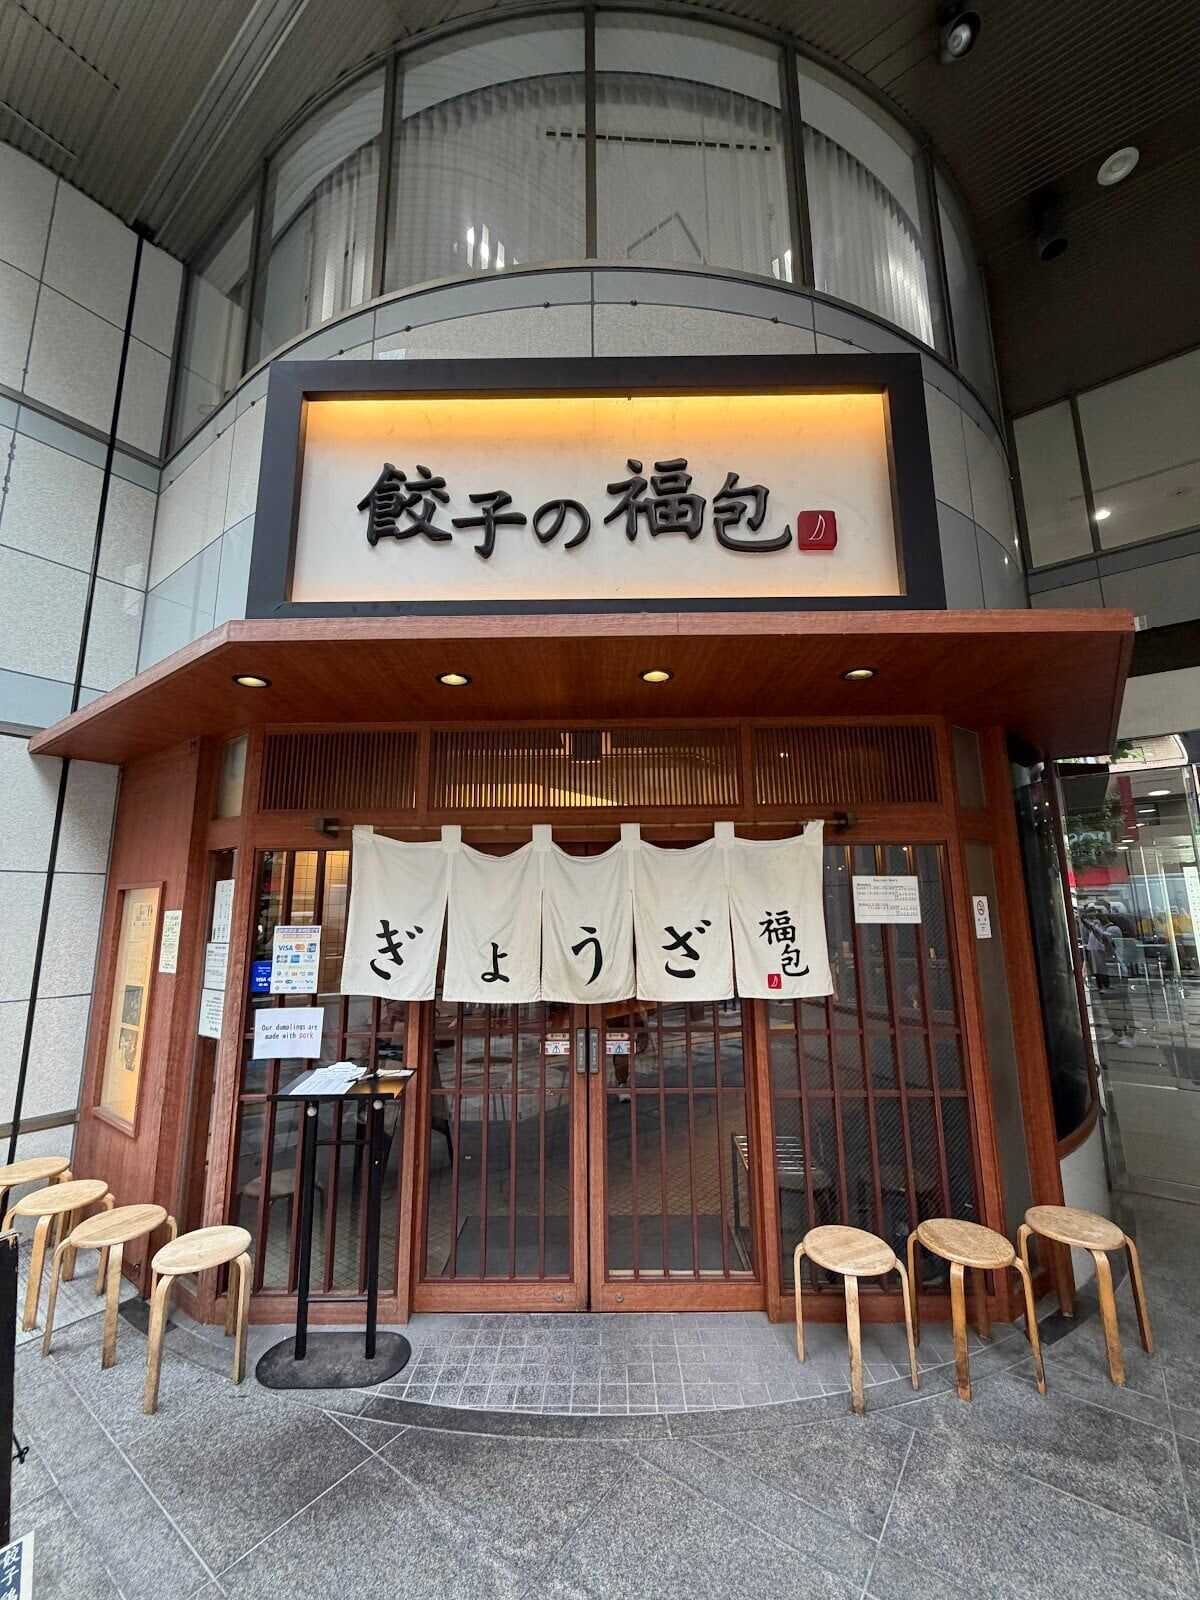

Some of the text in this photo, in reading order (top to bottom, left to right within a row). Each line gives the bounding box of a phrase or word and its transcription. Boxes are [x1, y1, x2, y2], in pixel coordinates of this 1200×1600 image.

[357, 458, 792, 560] 餃子の福包
[369, 919, 712, 986] ぎょうざ
[759, 910, 810, 977] 福包
[275, 1023, 306, 1031] dumplings
[282, 1031, 297, 1039] with
